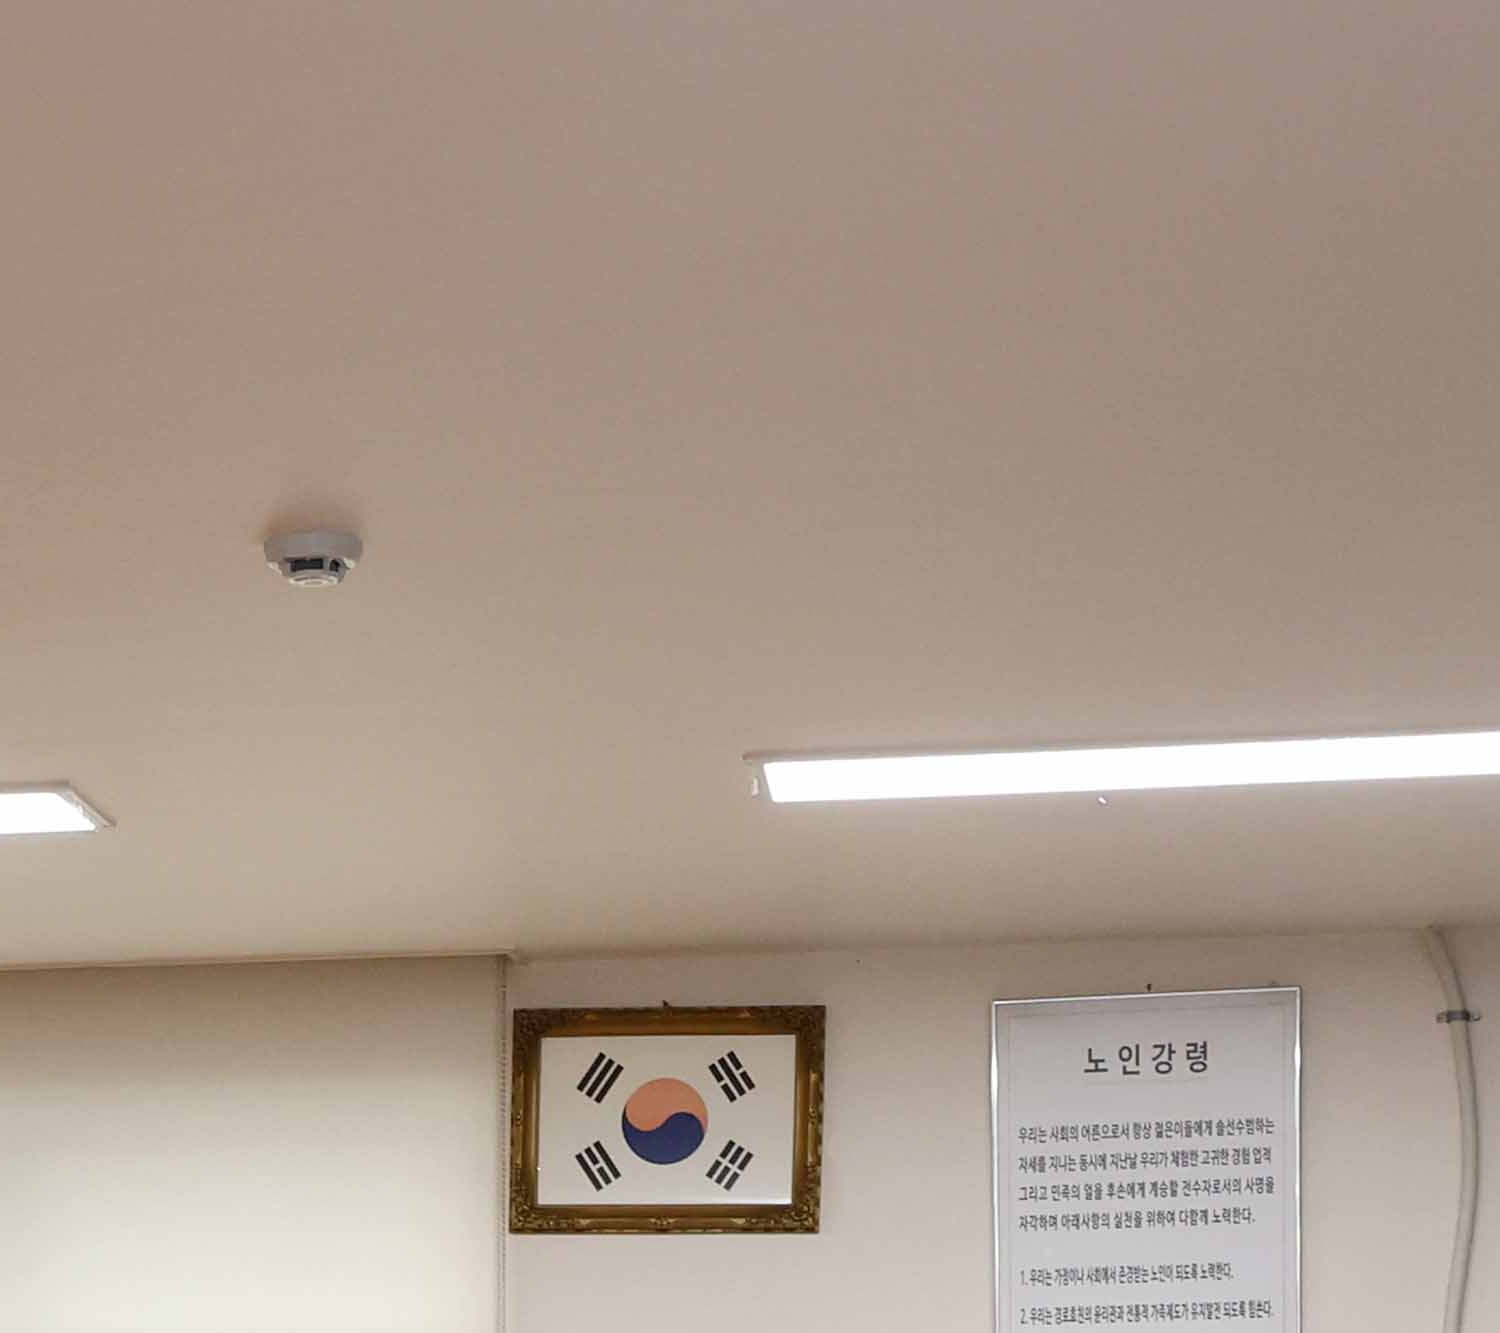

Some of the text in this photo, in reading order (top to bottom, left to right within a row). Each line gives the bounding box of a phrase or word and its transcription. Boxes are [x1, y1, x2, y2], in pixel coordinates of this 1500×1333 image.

[1018, 1127, 1046, 1144] 우리는
[1050, 1124, 1079, 1143] 사회의
[1081, 1122, 1129, 1142] 어른으로서
[1049, 1154, 1076, 1172] 지니는
[1080, 1152, 1107, 1171] 동시에
[1110, 1151, 1137, 1169] 지난날
[1140, 1151, 1168, 1168] 우리가
[1019, 1184, 1047, 1201] 그리고
